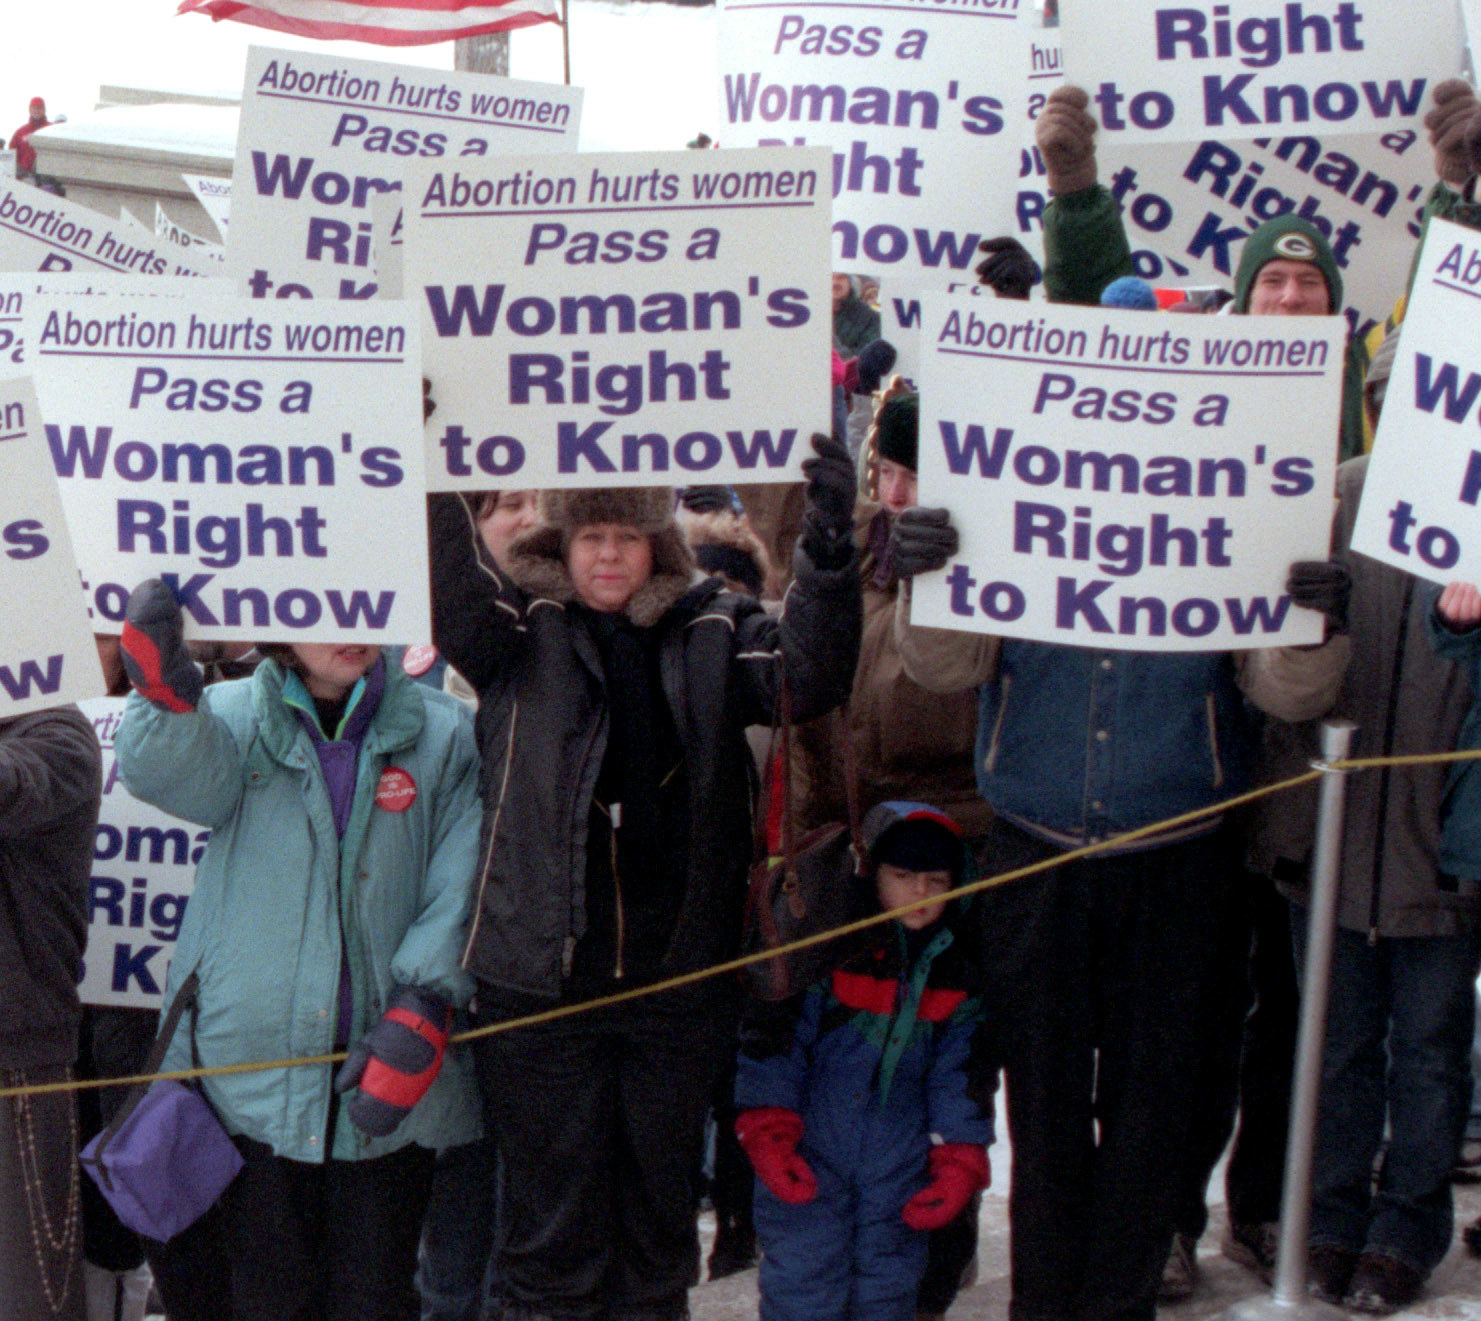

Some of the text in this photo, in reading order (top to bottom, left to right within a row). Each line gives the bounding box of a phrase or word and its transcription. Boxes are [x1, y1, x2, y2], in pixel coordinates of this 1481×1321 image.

[774, 15, 928, 60] Pass a
[1155, 3, 1365, 68] Right
[259, 60, 570, 125] Abortion hurts women
[724, 72, 1004, 136] Woman's
[1095, 73, 1428, 131] to Know
[331, 113, 448, 157] Pass
[421, 170, 576, 208] Abortion
[588, 168, 680, 205] hurts
[691, 168, 817, 200] women
[96, 232, 168, 277] hurts
[524, 222, 721, 266] Pass a
[832, 220, 983, 270] now
[40, 310, 176, 348] Abortion
[186, 314, 272, 351] hurts
[285, 323, 406, 353] women
[424, 275, 811, 337] Woman's
[938, 310, 1329, 367] Abortion hurts women
[129, 366, 313, 413] Pass a
[508, 350, 731, 417] Right
[1032, 373, 1230, 427] Pass a
[44, 423, 404, 488] Woman's
[439, 421, 798, 477] to Know
[938, 421, 1315, 497] Woman's
[117, 498, 328, 568] Right
[1013, 500, 1233, 577] Right
[1388, 499, 1461, 570] to
[160, 572, 396, 629] Know
[946, 564, 1293, 638] to Know
[89, 876, 191, 943] Rig
